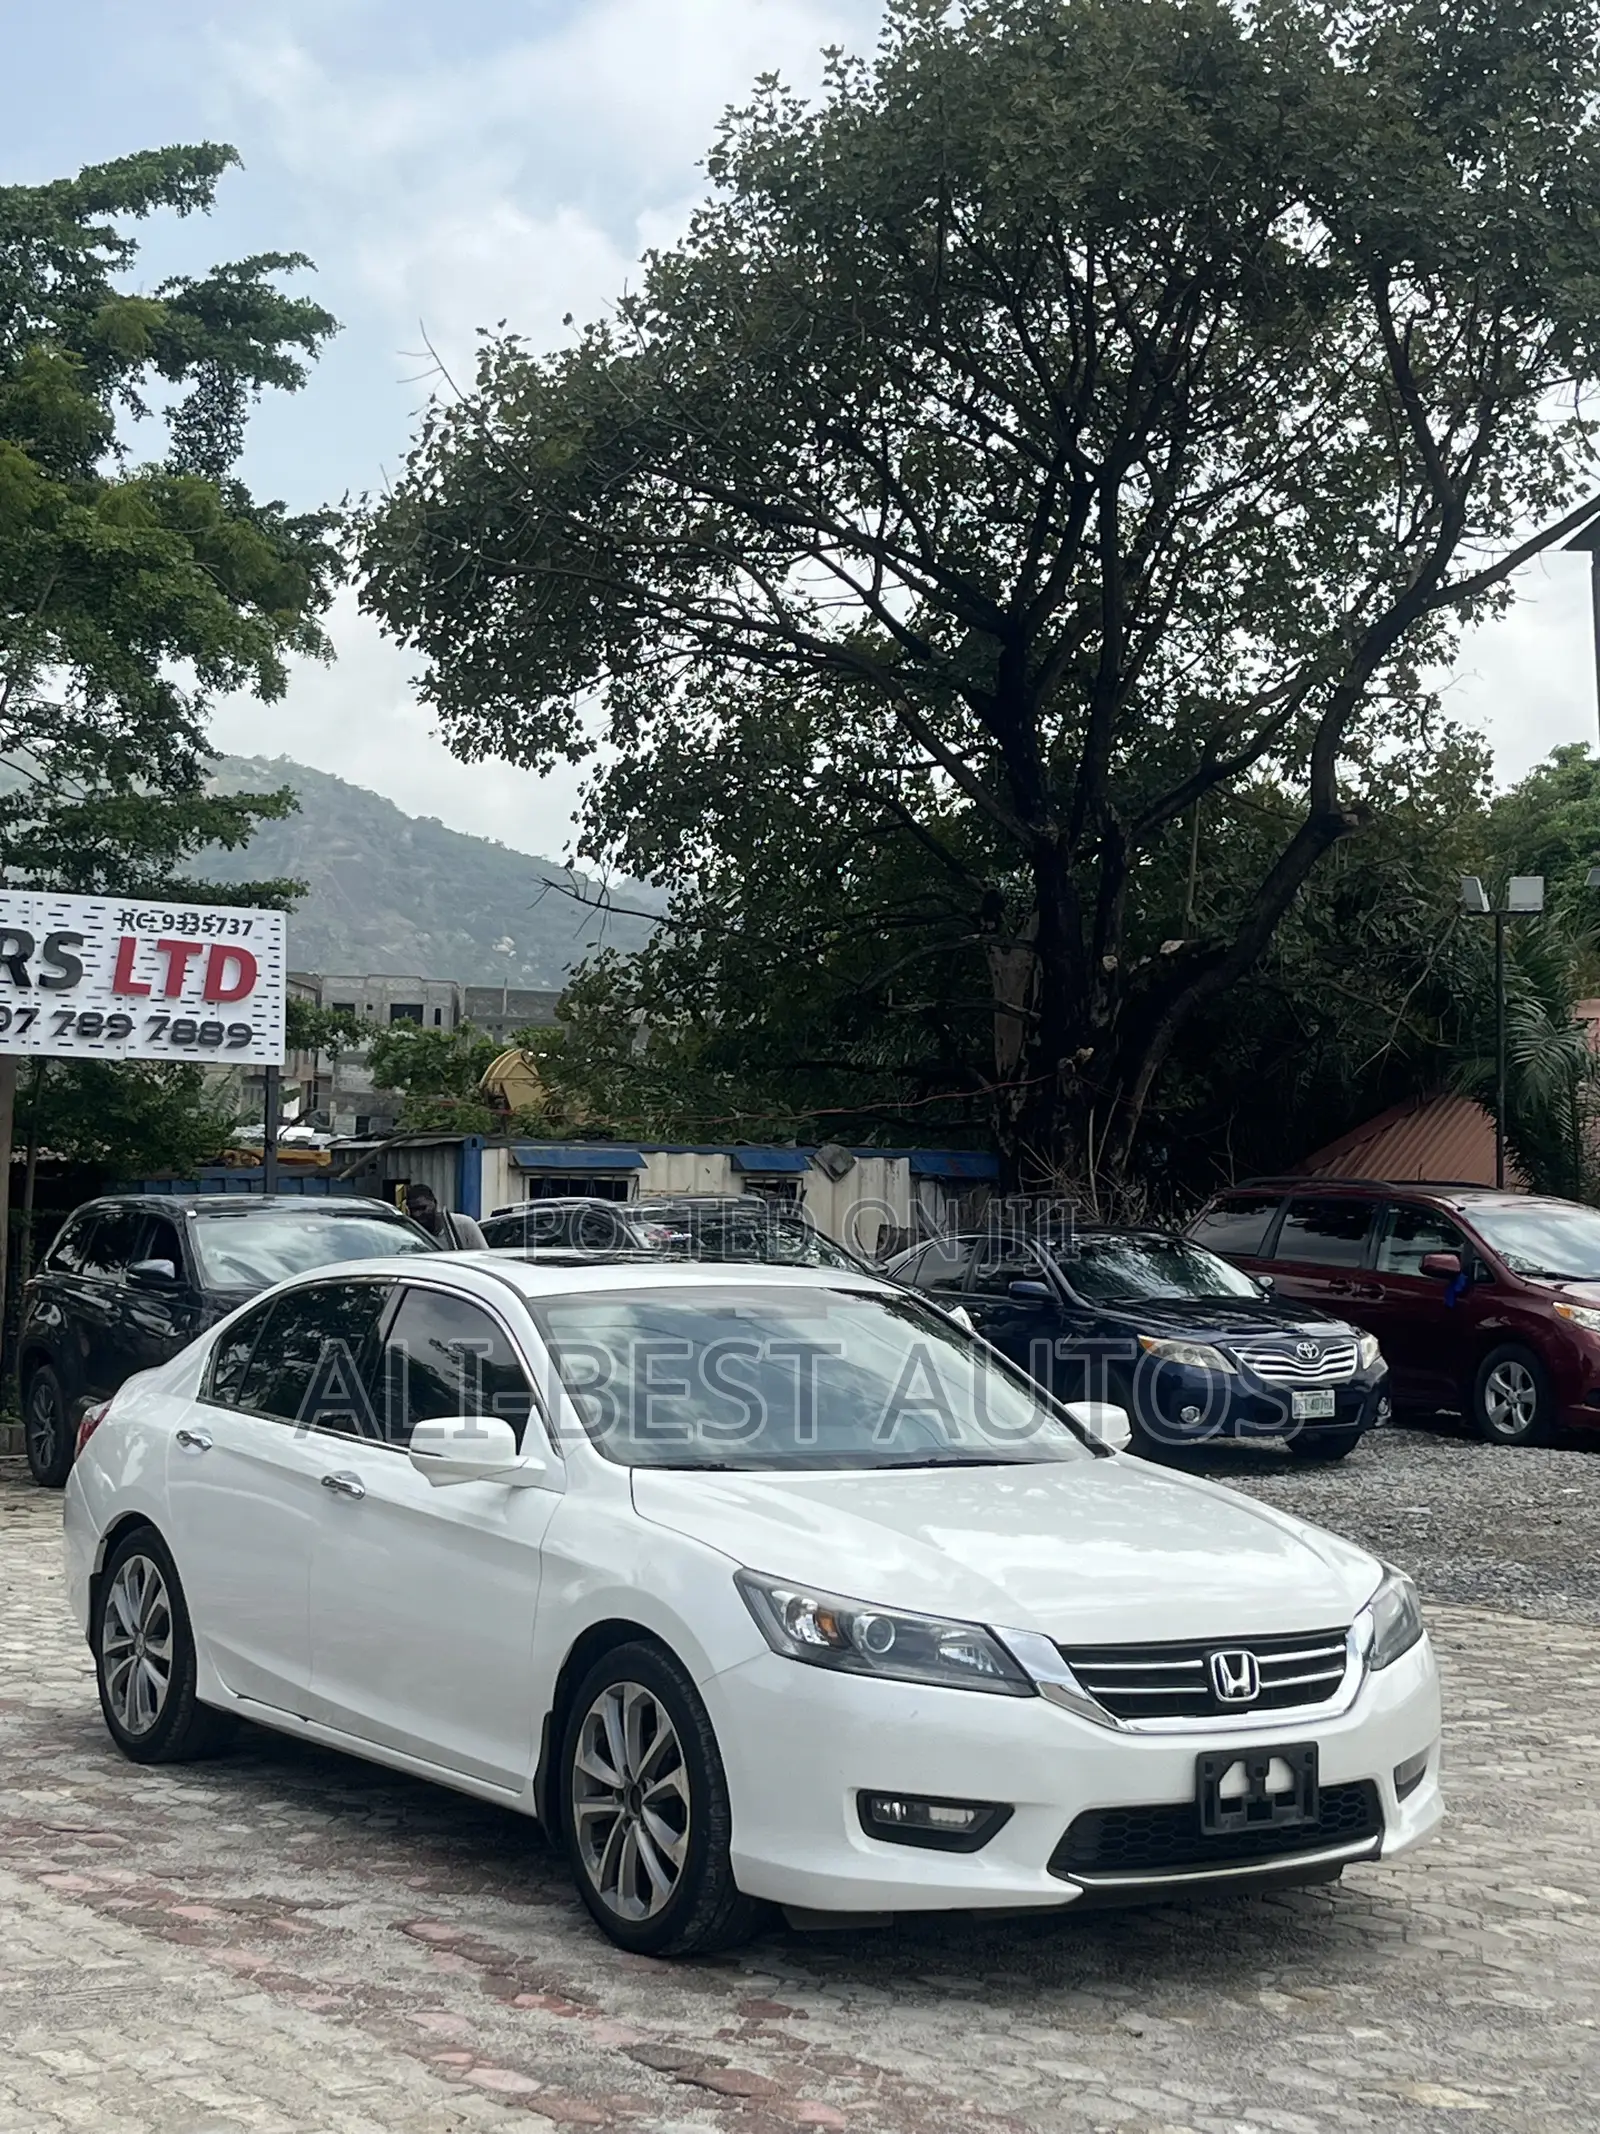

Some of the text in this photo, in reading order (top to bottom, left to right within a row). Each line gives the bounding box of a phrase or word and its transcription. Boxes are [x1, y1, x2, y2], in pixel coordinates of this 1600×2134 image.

[0, 926, 258, 1003] RS LTD
[51, 1010, 133, 1040] 789
[146, 1015, 254, 1049] 7889
